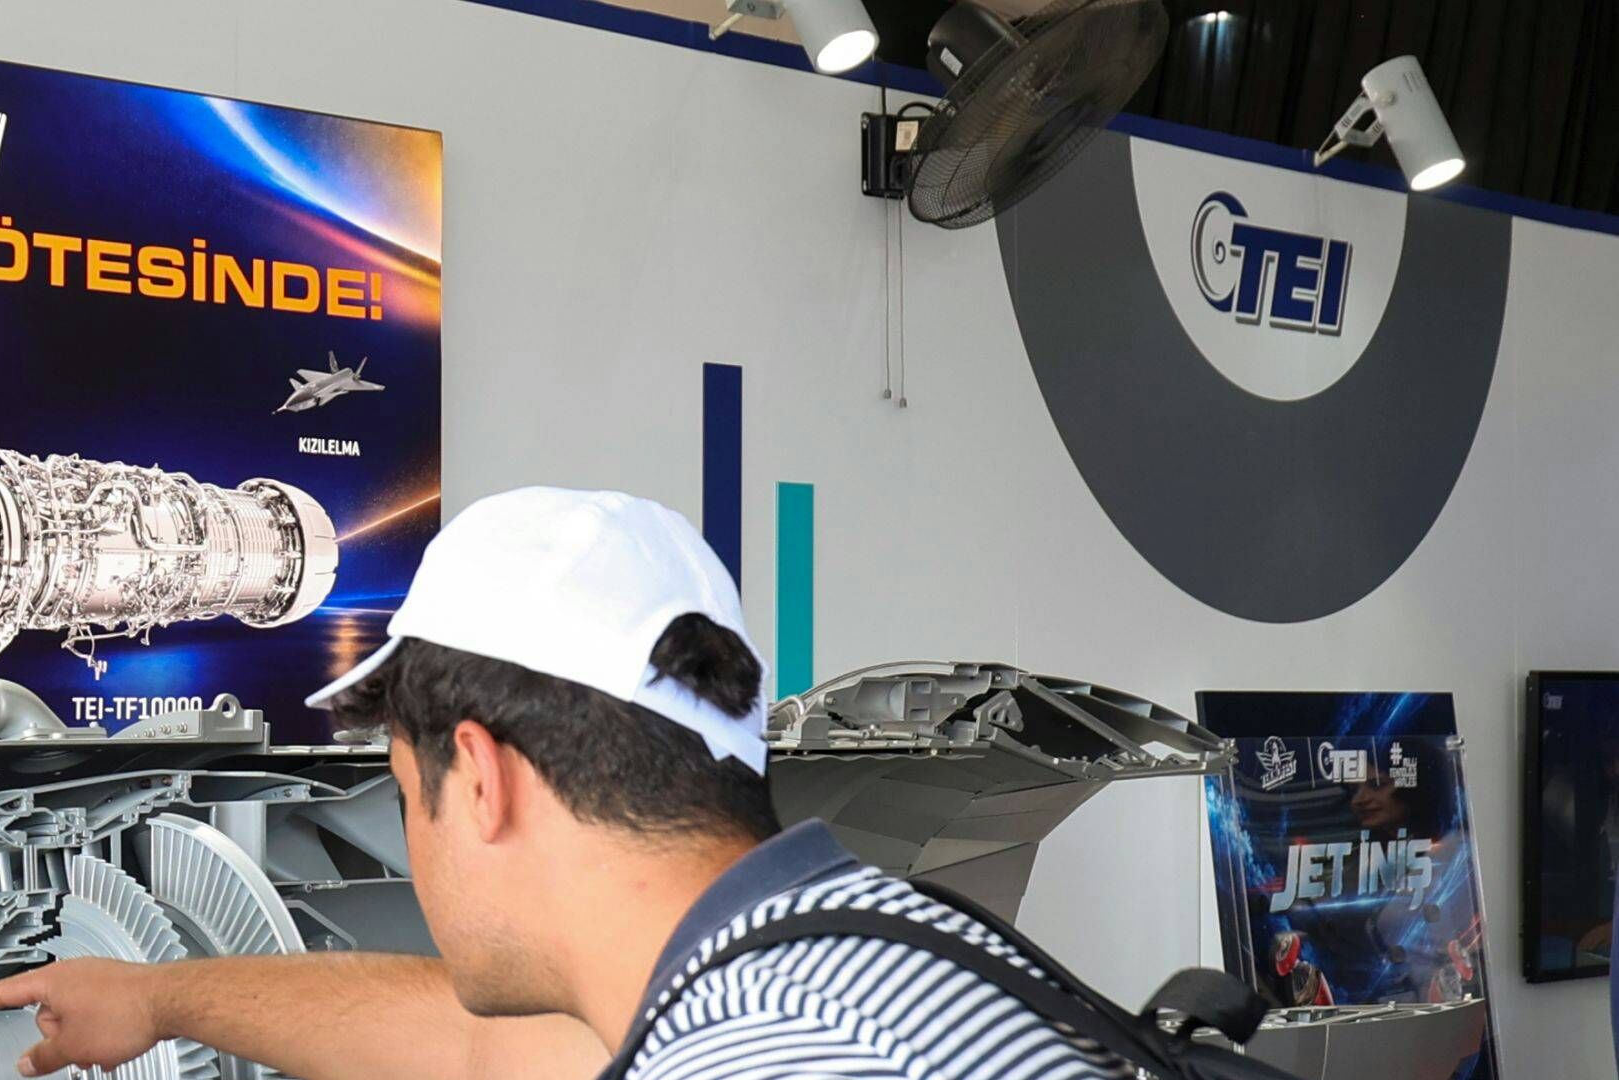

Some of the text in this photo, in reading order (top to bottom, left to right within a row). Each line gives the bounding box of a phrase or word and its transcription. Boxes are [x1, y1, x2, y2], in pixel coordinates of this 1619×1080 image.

[1231, 222, 1353, 337] TEI
[298, 437, 361, 457] KIZILELMA
[72, 696, 202, 720] TEI-TF10000
[1270, 842, 1352, 913] JET
